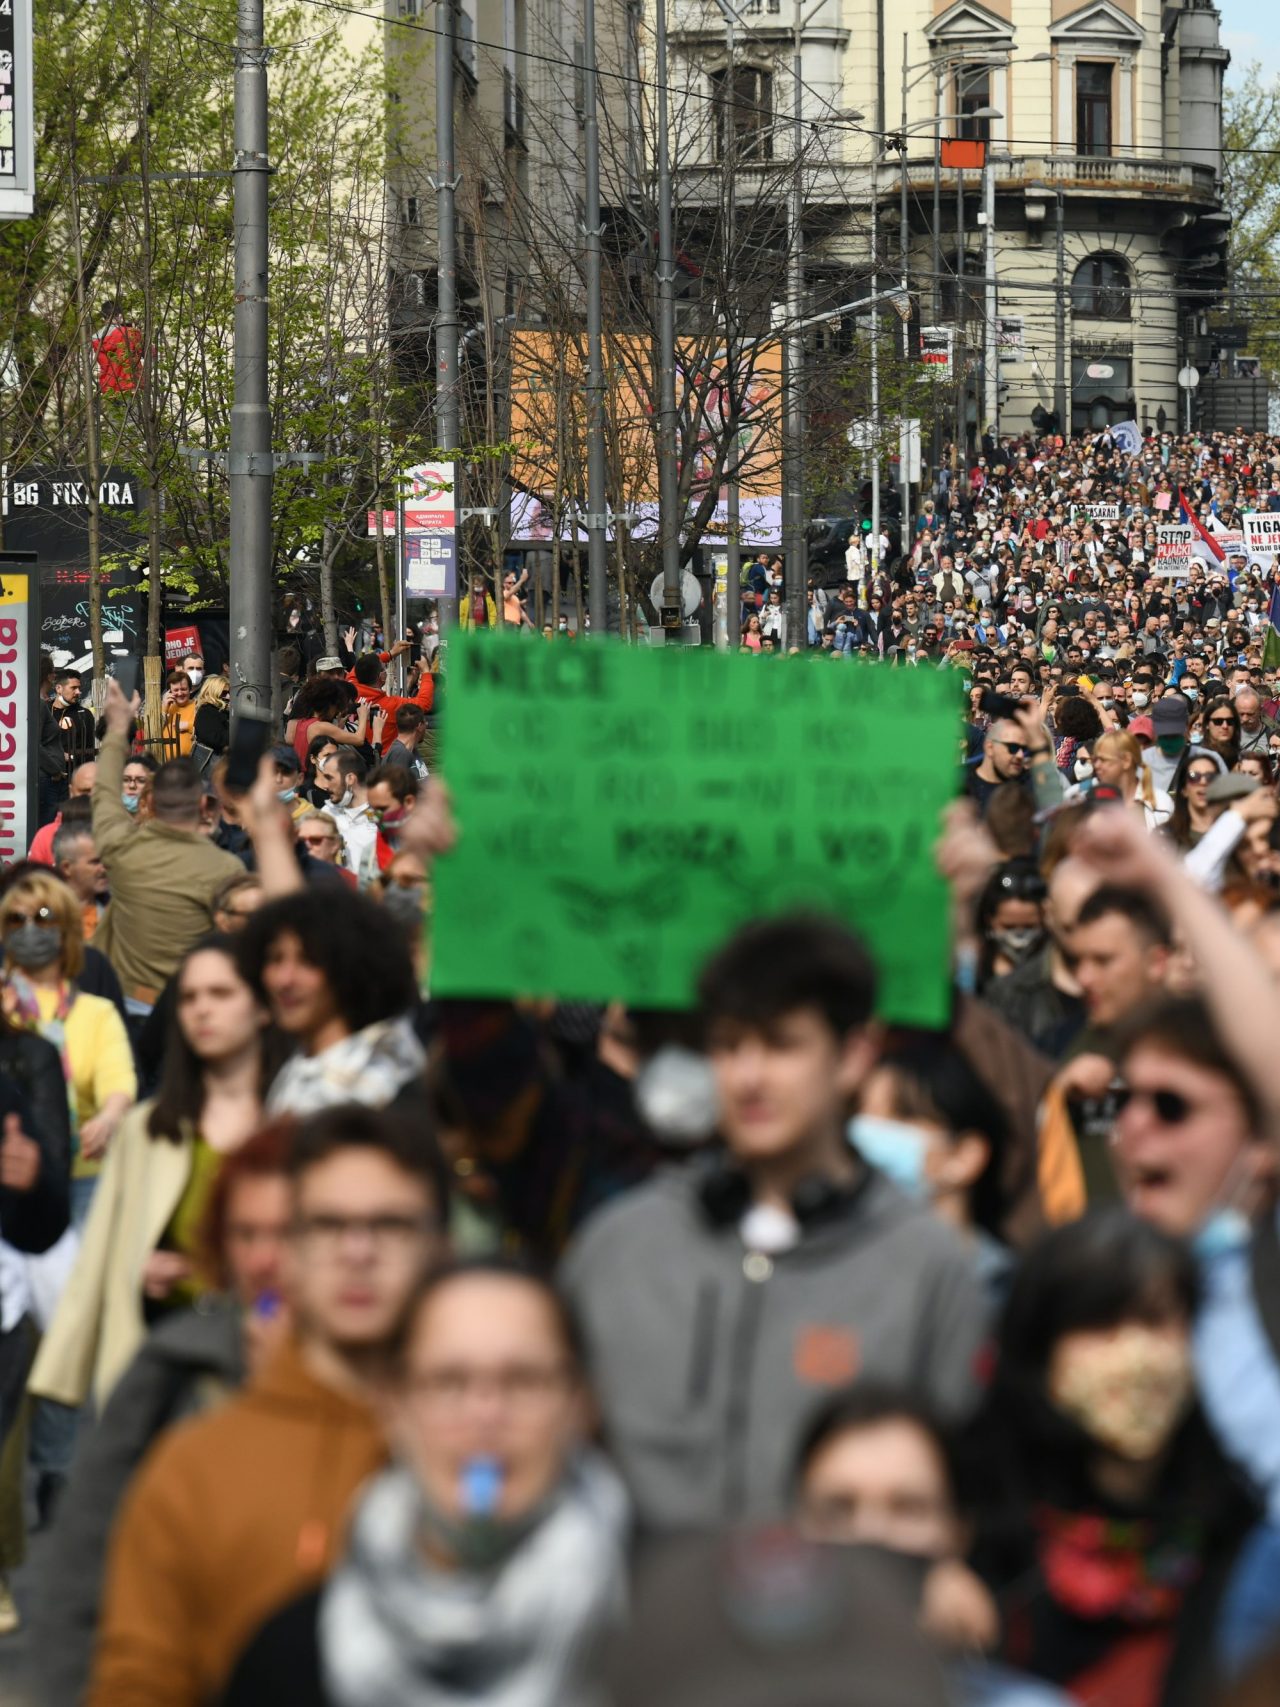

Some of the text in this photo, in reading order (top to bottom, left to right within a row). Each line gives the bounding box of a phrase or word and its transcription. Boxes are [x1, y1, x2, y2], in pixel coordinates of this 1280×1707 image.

[14, 482, 39, 506] BG
[1160, 531, 1191, 545] STOP
[1251, 534, 1263, 545] NE
[184, 636, 195, 647] JE
[166, 646, 193, 660] JEDNO
